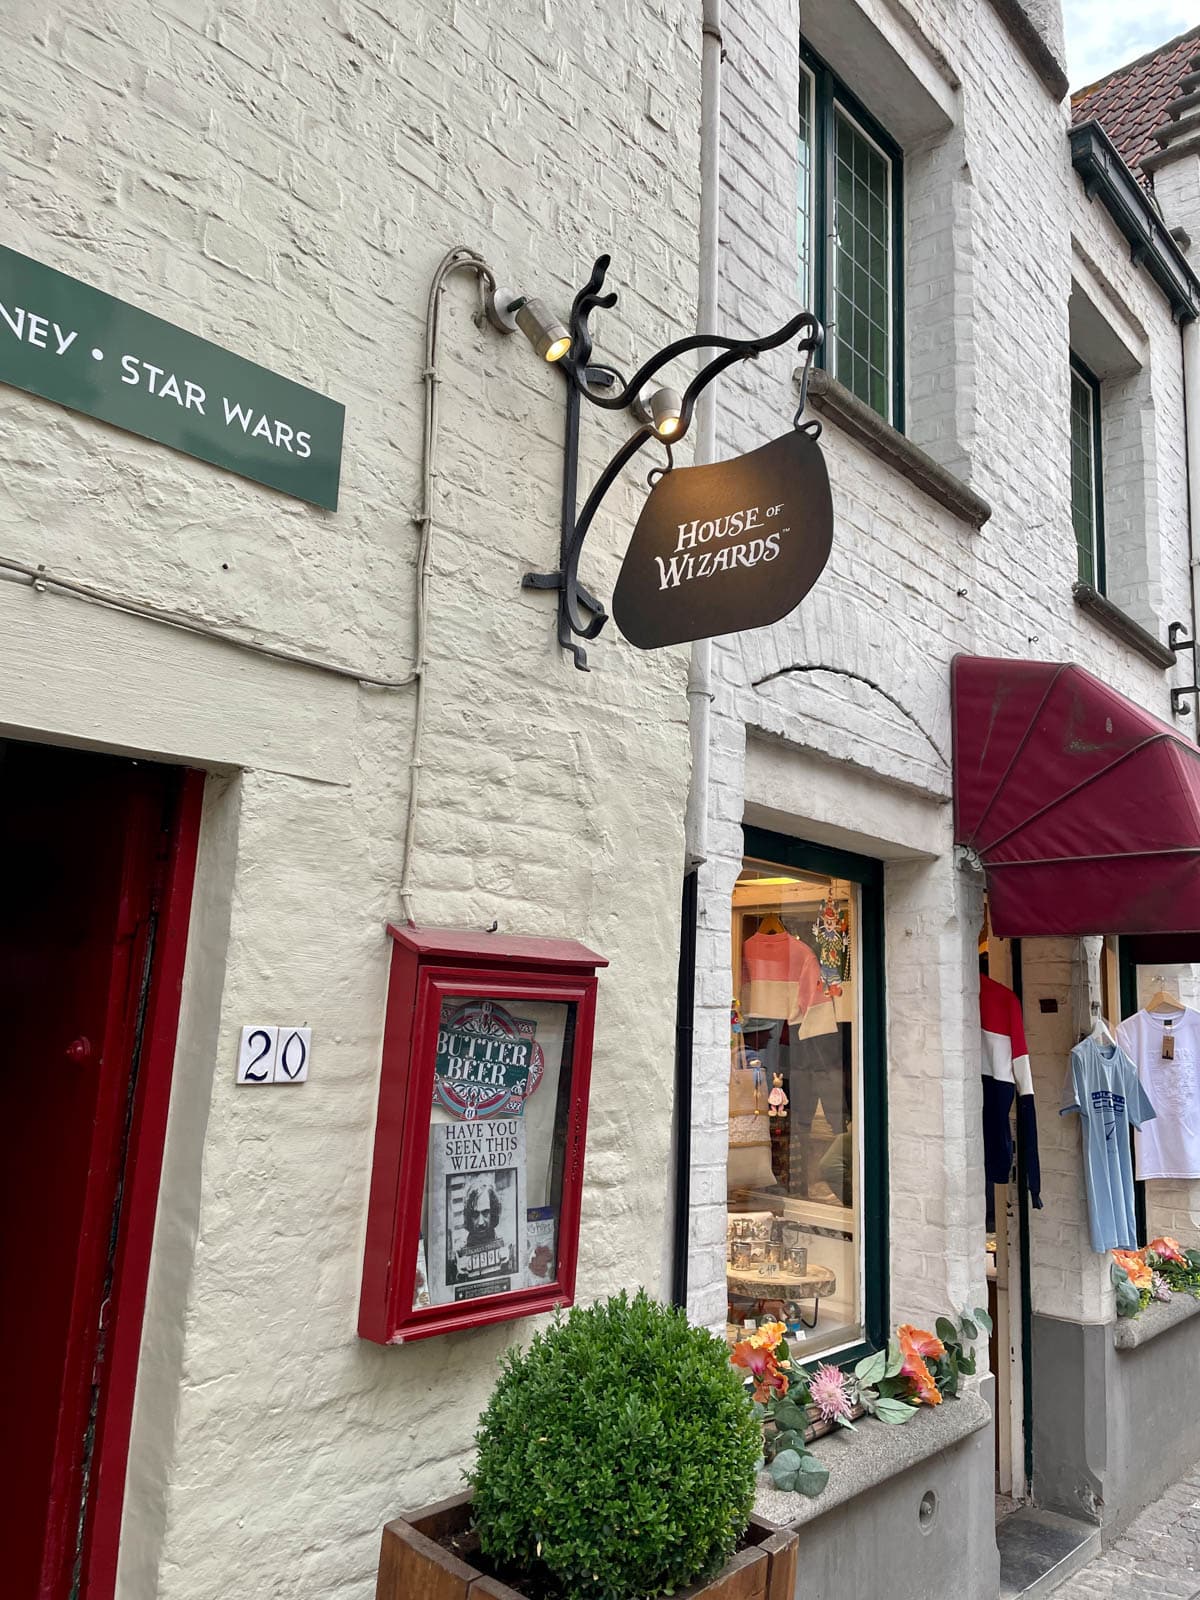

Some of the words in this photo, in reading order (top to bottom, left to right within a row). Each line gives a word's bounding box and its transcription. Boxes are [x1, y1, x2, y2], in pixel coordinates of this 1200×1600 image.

[121, 355, 206, 416] STAR
[223, 397, 312, 459] WARS
[673, 507, 765, 553] HOUSE
[766, 503, 785, 518] OF
[654, 532, 781, 590] WIZARDS
[244, 1030, 306, 1081] 20
[436, 1029, 528, 1067] BUTTER
[443, 1056, 507, 1086] BEER
[445, 1123, 484, 1140] HAVE
[487, 1120, 518, 1137] YOU
[445, 1138, 482, 1156] SEEN
[486, 1136, 518, 1152] THIS
[451, 1151, 513, 1171] WIZARD?
